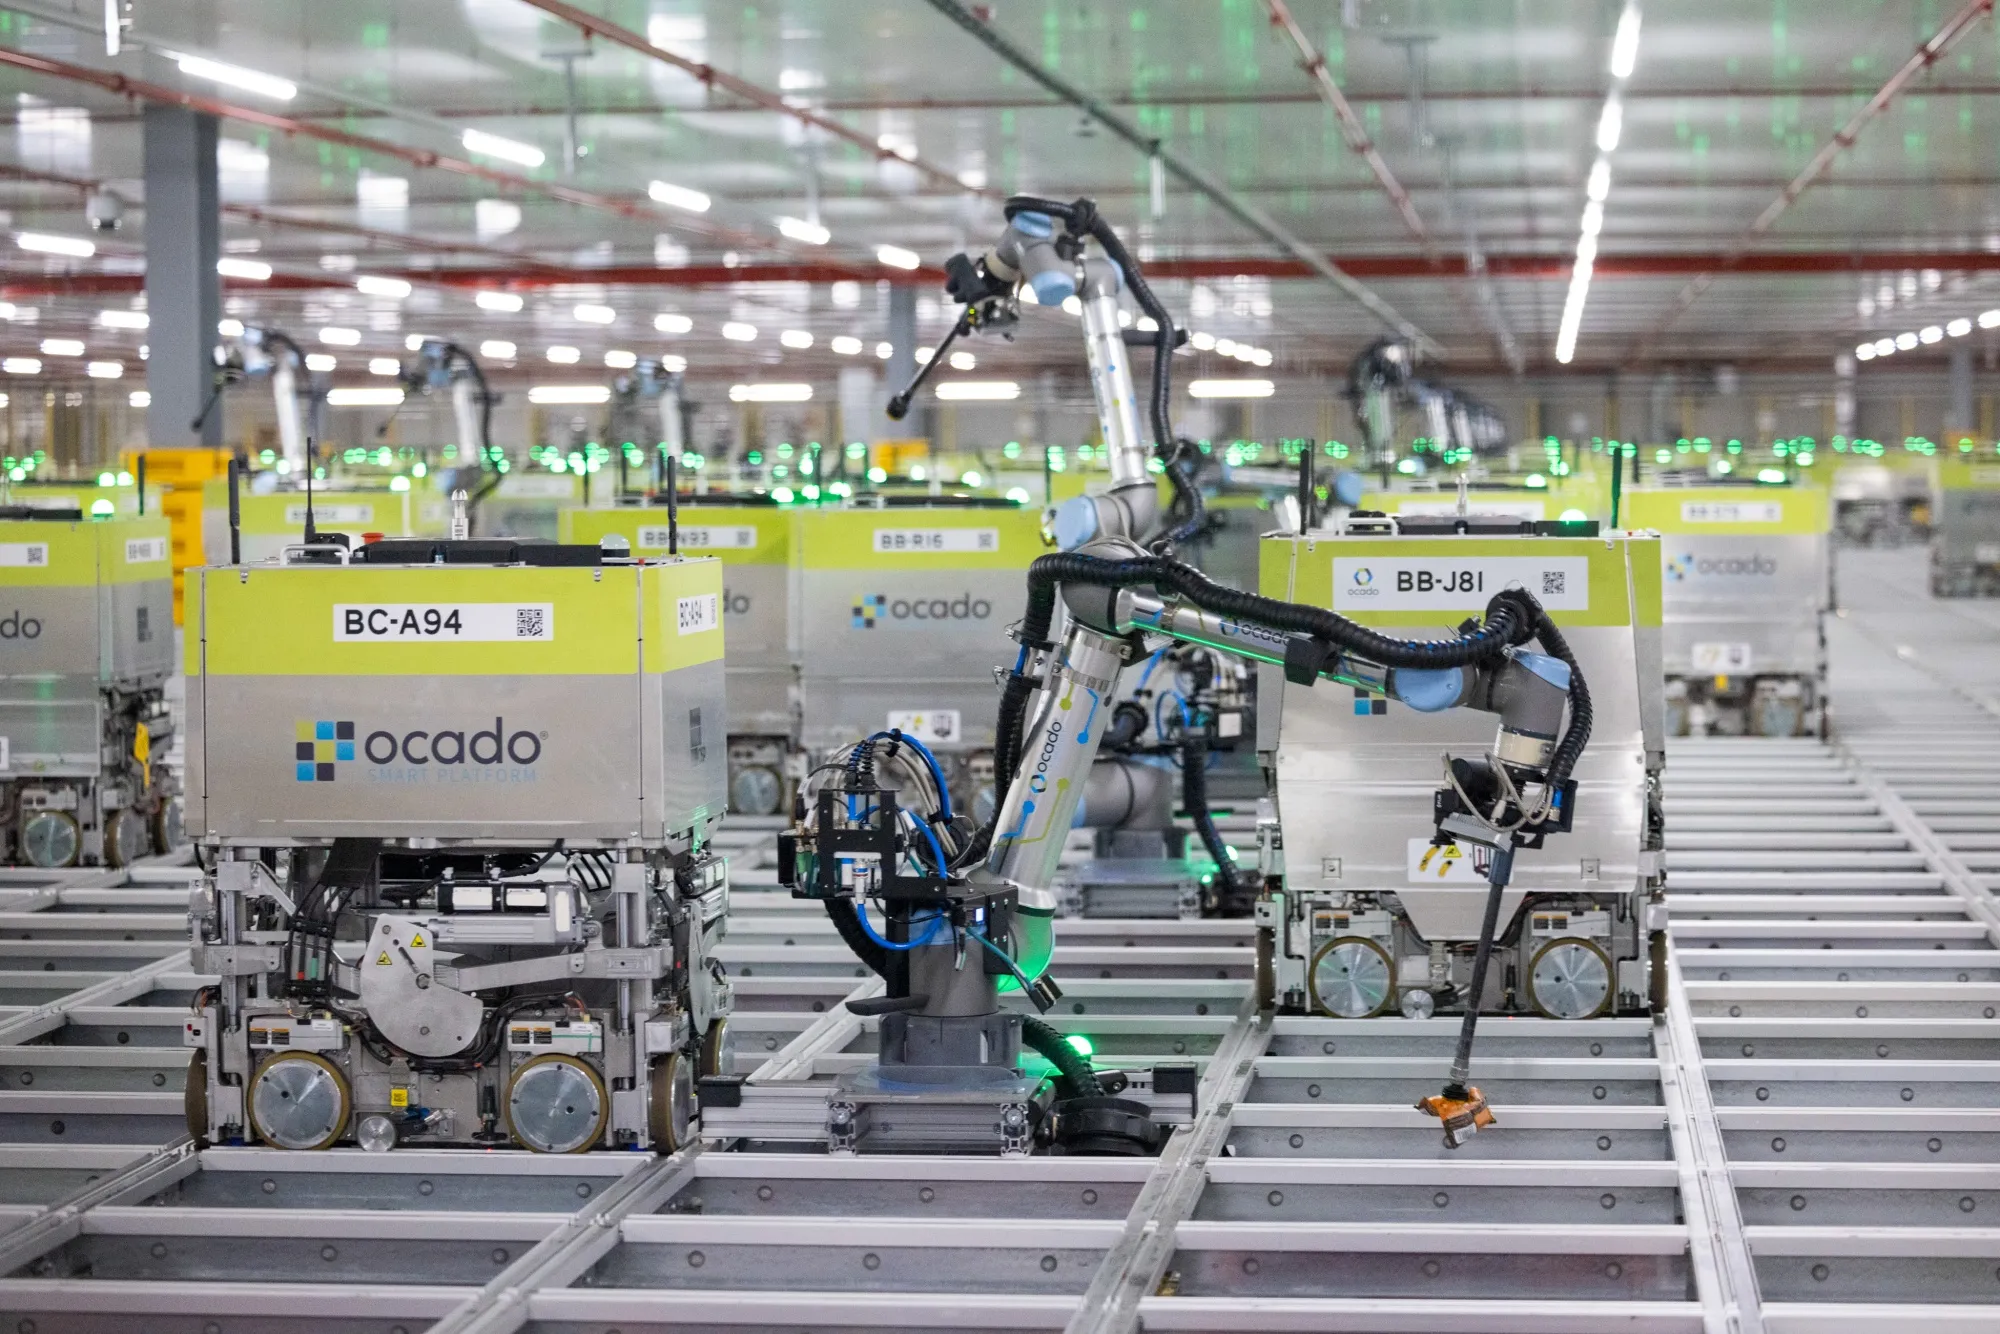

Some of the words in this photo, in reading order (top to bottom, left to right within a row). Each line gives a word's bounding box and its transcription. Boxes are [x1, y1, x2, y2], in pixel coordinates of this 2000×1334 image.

[1697, 550, 1777, 576] ocado
[1348, 587, 1379, 595] ocado
[891, 592, 991, 620] ocado
[345, 608, 462, 635] BC-A94
[1037, 721, 1062, 773] ocado
[367, 768, 430, 783] SMART
[437, 768, 537, 783] PLATFORM
